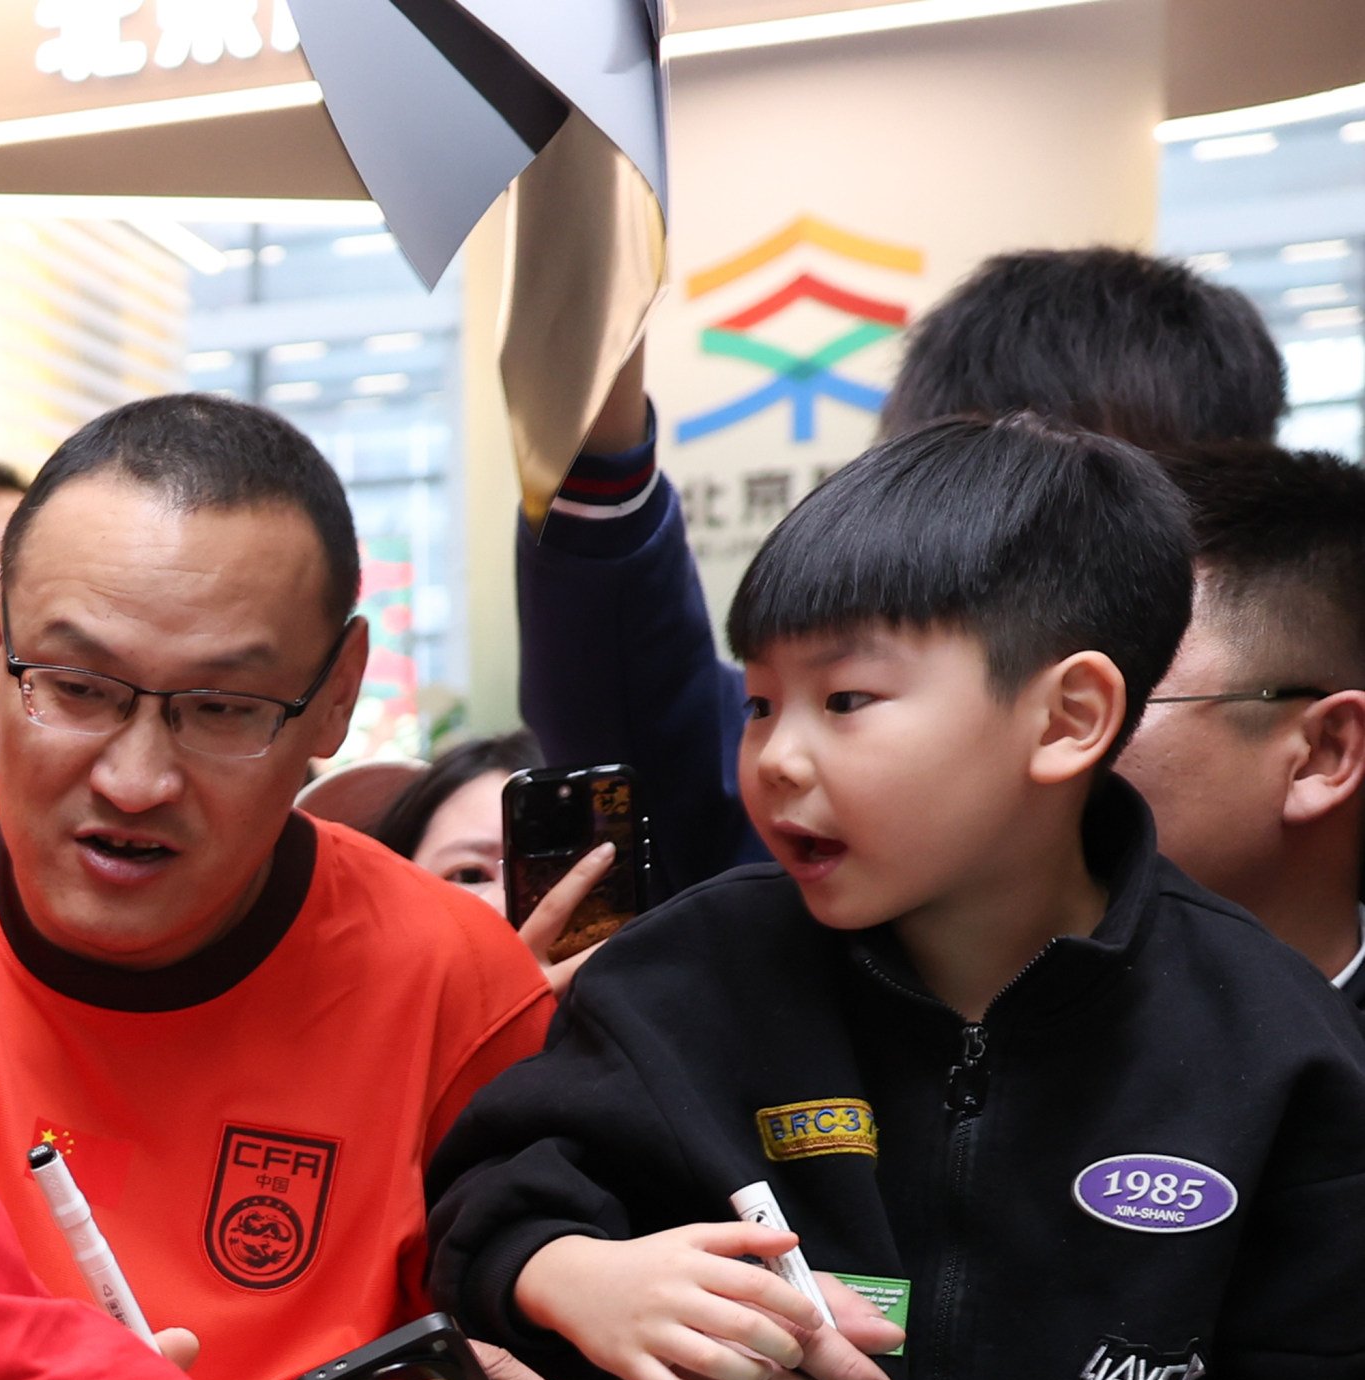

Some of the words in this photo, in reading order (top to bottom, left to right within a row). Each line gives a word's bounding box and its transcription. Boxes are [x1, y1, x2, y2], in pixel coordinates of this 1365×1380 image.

[233, 1140, 321, 1179] CFA
[256, 1173, 290, 1194] 中国
[1102, 1170, 1206, 1210] 1985
[1114, 1204, 1186, 1223] XIN-SHANG
